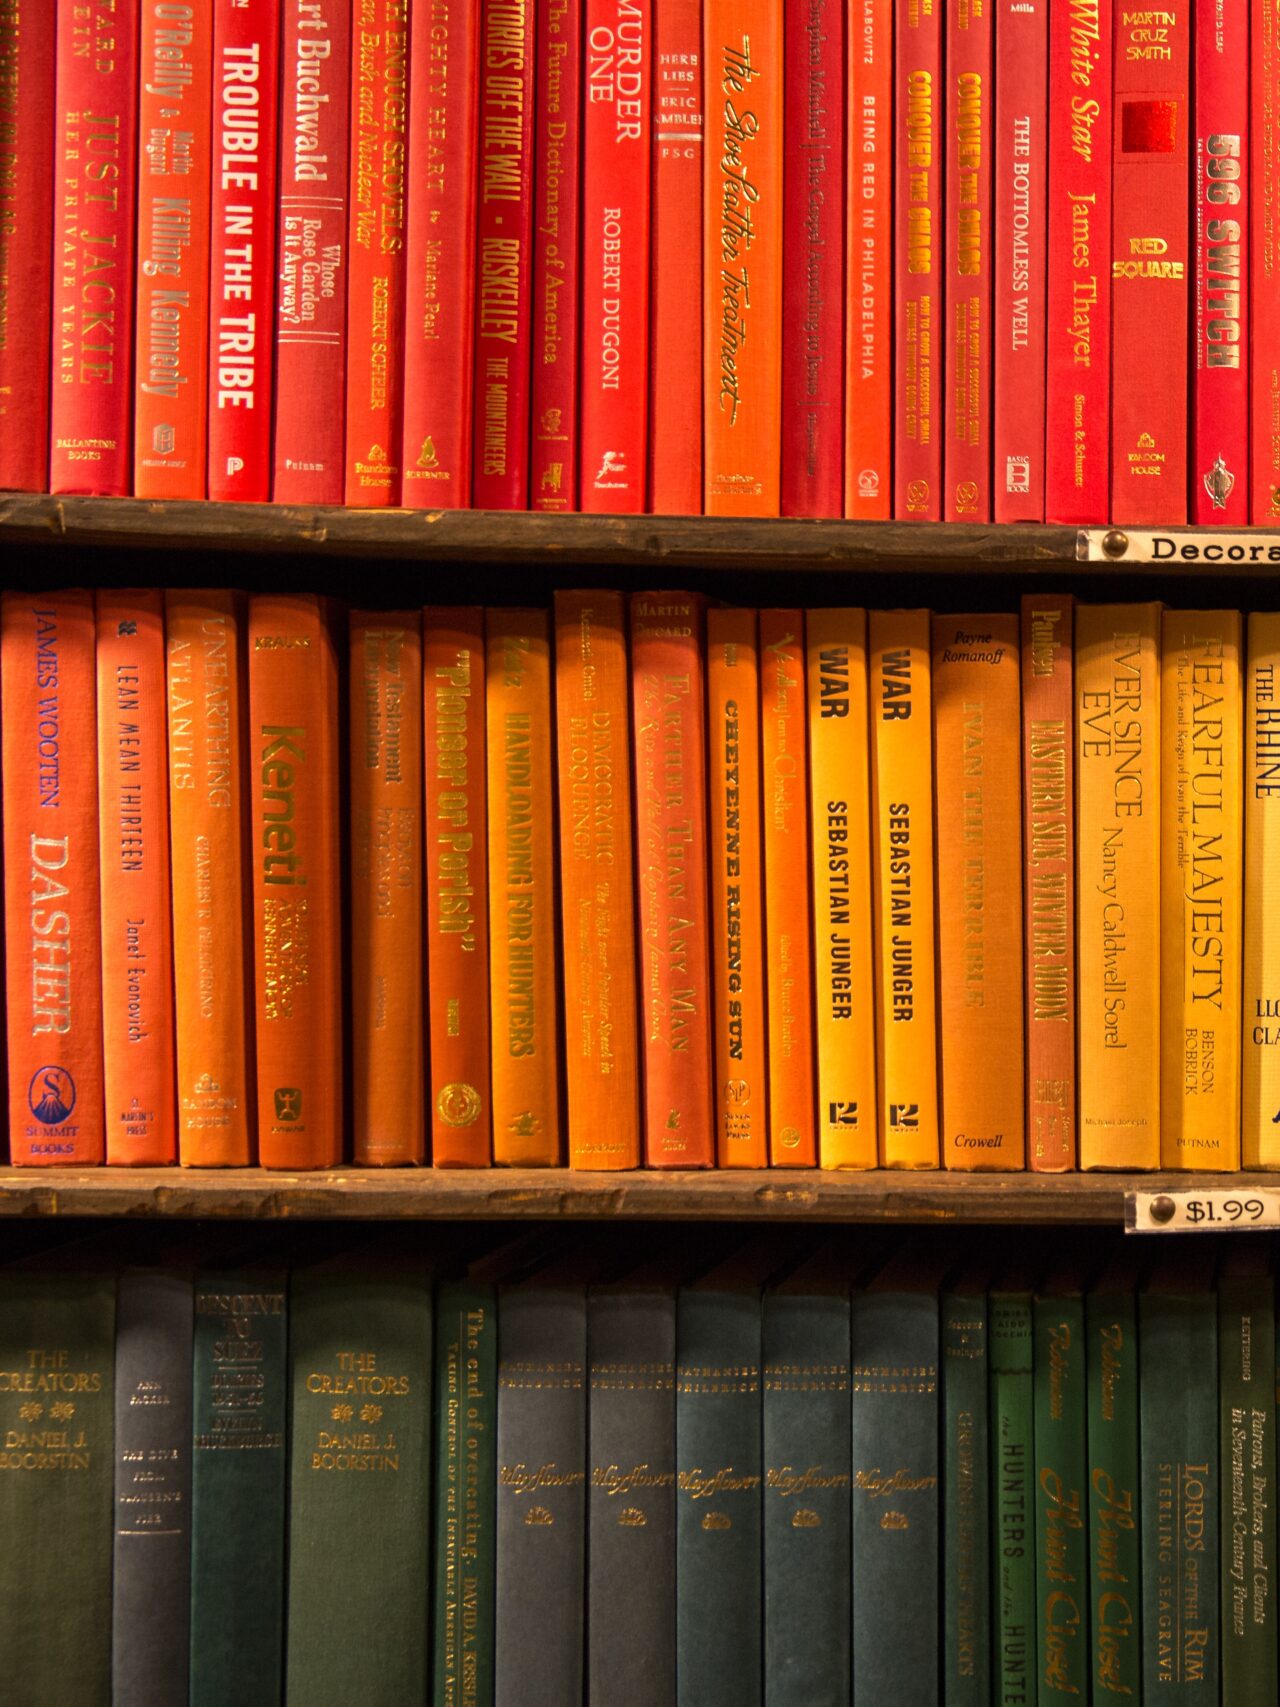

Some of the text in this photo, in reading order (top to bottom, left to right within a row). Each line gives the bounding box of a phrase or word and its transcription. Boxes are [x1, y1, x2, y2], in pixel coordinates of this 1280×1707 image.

[589, 26, 614, 103] ONE
[617, 0, 641, 143] MURDER
[1067, 0, 1100, 161] White Star
[1122, 12, 1176, 25] MARTIN
[1126, 47, 1171, 60] SMITH
[1130, 30, 1168, 42] CRUZ
[295, 38, 330, 181] Buchwald
[61, 112, 80, 384] HER PRIVATE YEARS
[80, 110, 119, 384] JUST JACKIE
[141, 198, 192, 398] Killing Kennedy
[218, 43, 260, 409] TROUBLE IN THE TRIBE
[281, 216, 303, 324] Is It Anyway?
[300, 219, 321, 321] Rose Garden
[321, 245, 340, 298] Whose
[601, 208, 620, 389] ROBERT DUGONI
[862, 96, 875, 379] BEING RED IN PHILADELPHIA
[1012, 116, 1029, 350] THE BOTTOMLESS WELL
[1067, 192, 1096, 367] James Thayer
[1113, 261, 1184, 279] SQUARE
[1130, 238, 1168, 254] RED
[1206, 134, 1240, 369] 596 SWITCH
[33, 608, 60, 808] JAMES WOOTEN
[819, 647, 850, 719] WAR
[882, 649, 912, 721] WAR
[1083, 690, 1111, 758] EVE
[1113, 633, 1144, 817] EVER SINCE
[1255, 665, 1274, 702] THE
[117, 666, 143, 872] LEAN MEAN THIRTEEN
[1185, 633, 1224, 1011] FEARFUL MAJESTY
[30, 834, 71, 1037] DASHER
[126, 919, 148, 1043] Janet Evanovich
[828, 801, 852, 1019] SEBASTIAN JUNGER
[889, 803, 914, 1022] SEBASTIAN JUNGER
[1098, 828, 1127, 1048] Nancy Caldwell Sorel
[954, 1134, 1002, 1147] Crowell
[1186, 1199, 1264, 1223] $1.99
[1158, 1464, 1172, 1682] STERLING SEAGRAVE
